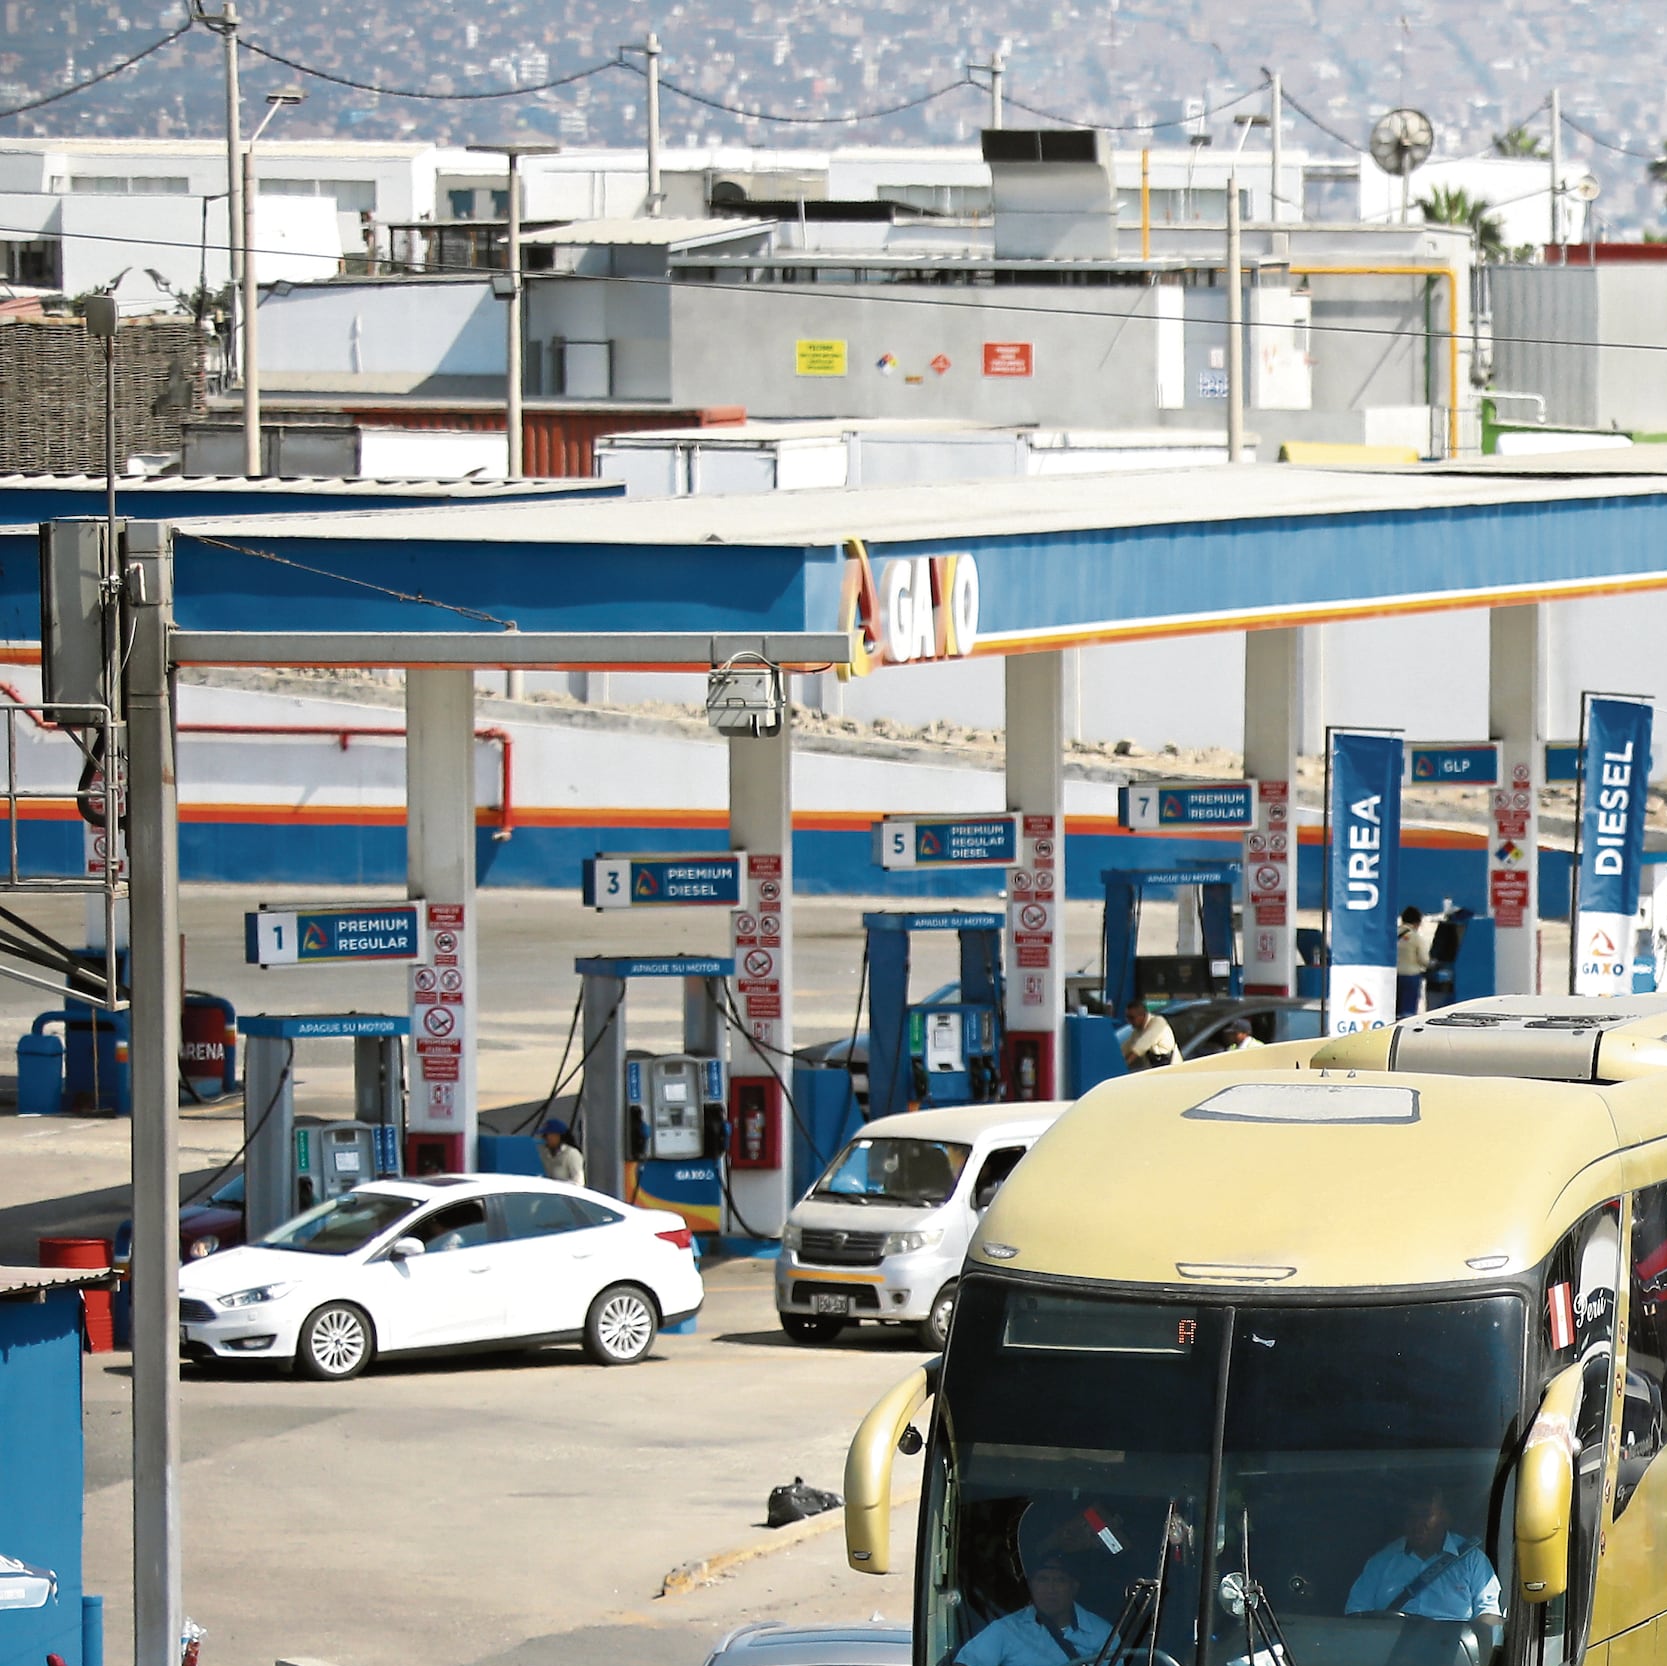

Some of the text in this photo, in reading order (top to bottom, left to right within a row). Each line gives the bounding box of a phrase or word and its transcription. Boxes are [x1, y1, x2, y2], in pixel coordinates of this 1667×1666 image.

[882, 552, 979, 662] GAXO
[1444, 760, 1470, 773] GLP
[1191, 794, 1244, 804] PREMIUM
[1139, 798, 1149, 817] 7
[1191, 809, 1244, 819] REGULAR
[1595, 740, 1633, 875] DIESEL
[952, 825, 1004, 835] PREMIUM
[894, 834, 905, 853] 5
[952, 848, 988, 858] DIESEL
[1346, 795, 1381, 911] UREA
[668, 869, 733, 880] PREMIUM
[607, 872, 619, 895] 3
[668, 884, 718, 896] DIESEL
[338, 919, 409, 933] PREMIUM
[272, 925, 283, 950] 1
[338, 937, 409, 951] REGULAR
[1582, 962, 1624, 977] GAXO
[299, 1022, 395, 1033] APAGUE SU MOTOR
[1573, 1289, 1607, 1329] Perú
